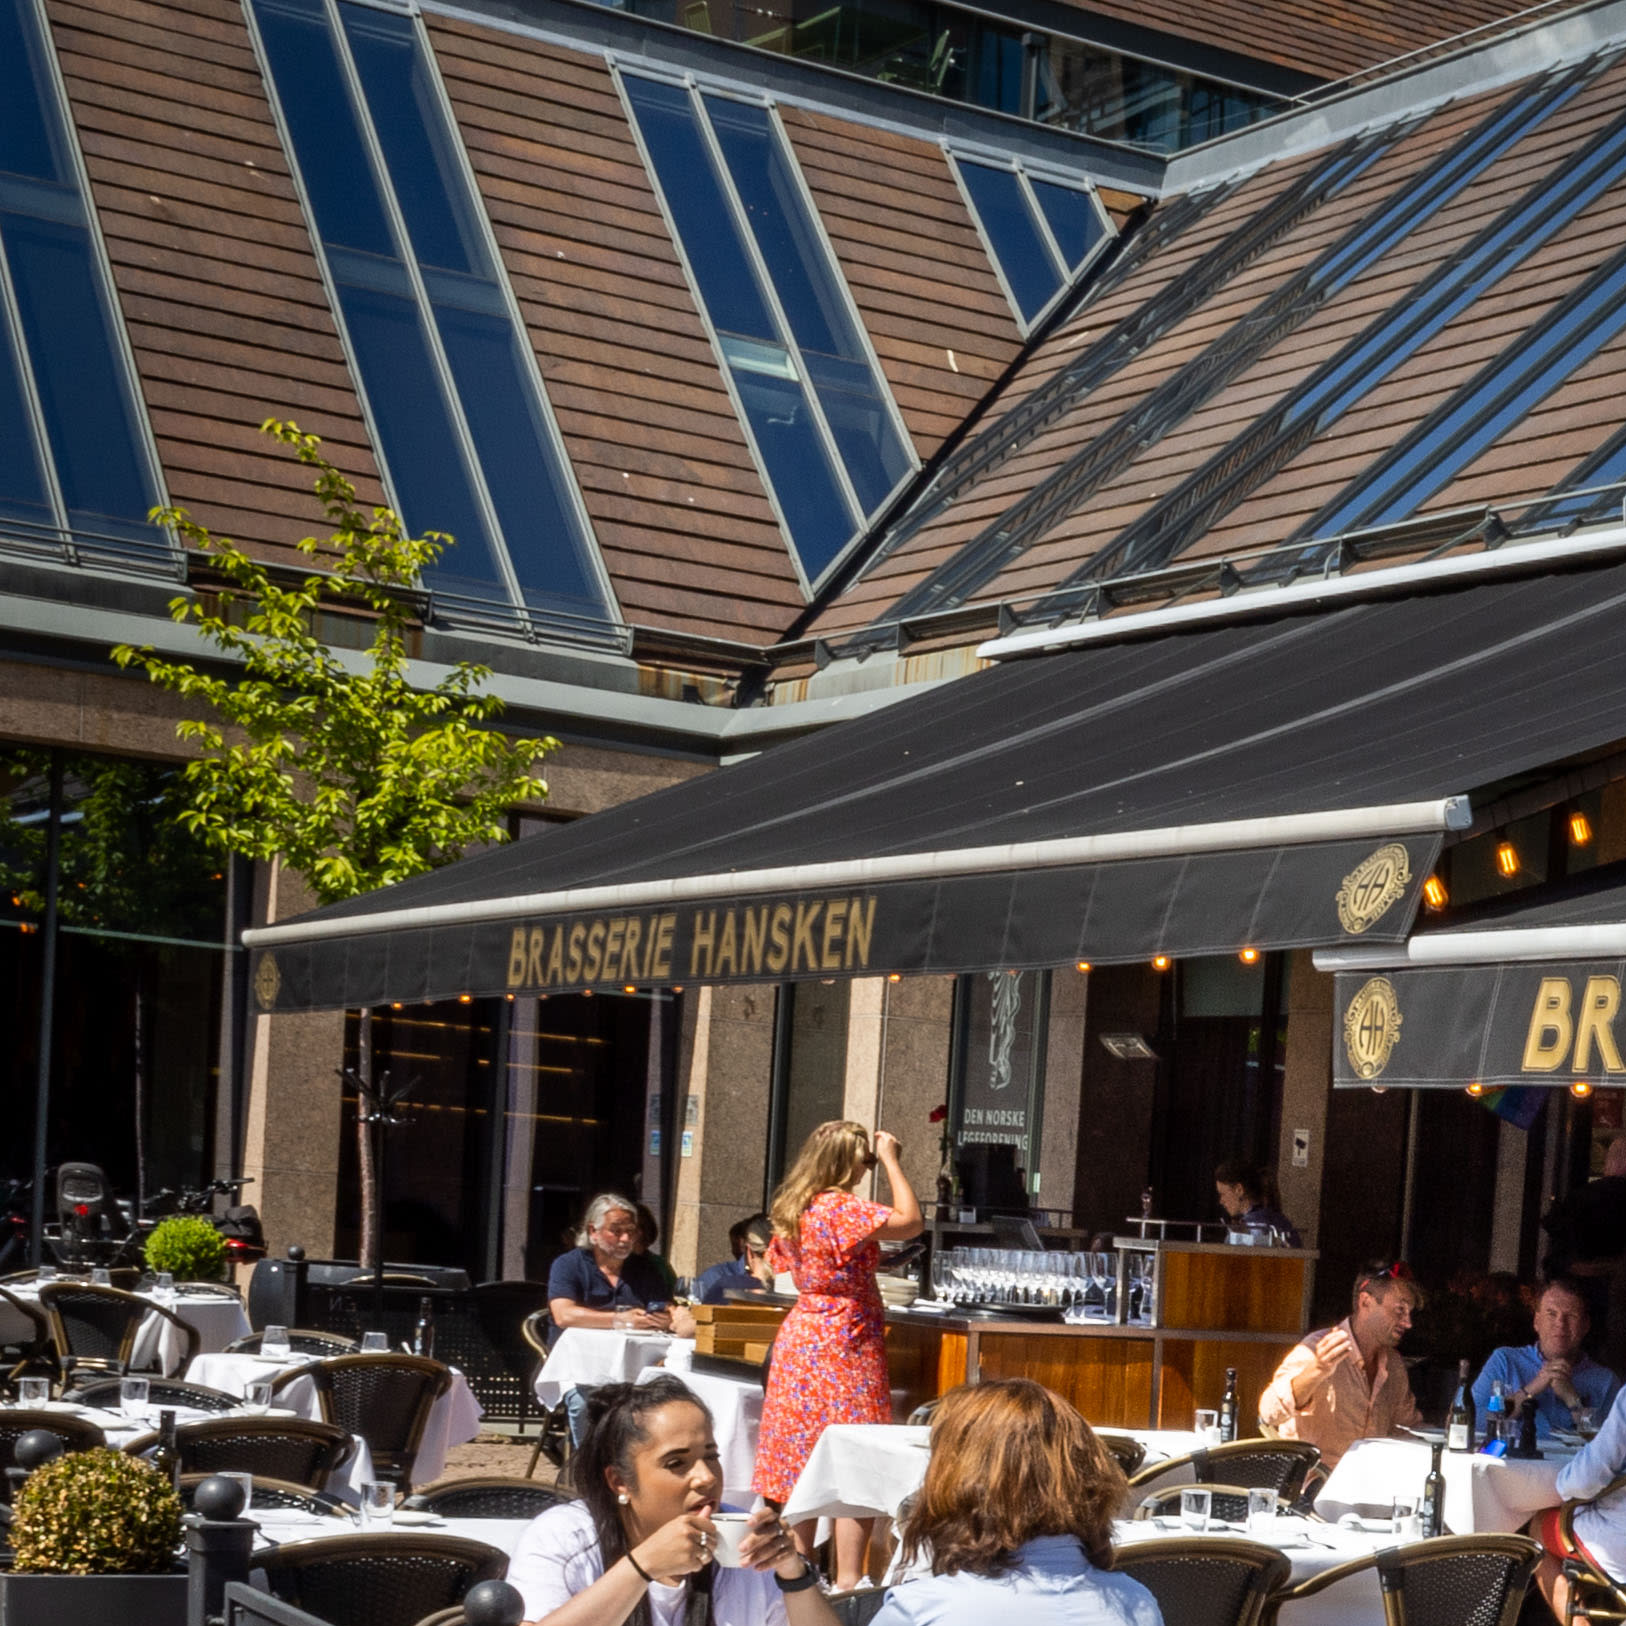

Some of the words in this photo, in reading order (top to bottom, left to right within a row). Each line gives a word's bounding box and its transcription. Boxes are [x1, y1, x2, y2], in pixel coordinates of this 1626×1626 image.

[508, 914, 677, 988] BRASSERIE
[690, 897, 877, 978] HANSKEN
[964, 1108, 984, 1125] DEN
[986, 1110, 1025, 1127] NORSKE
